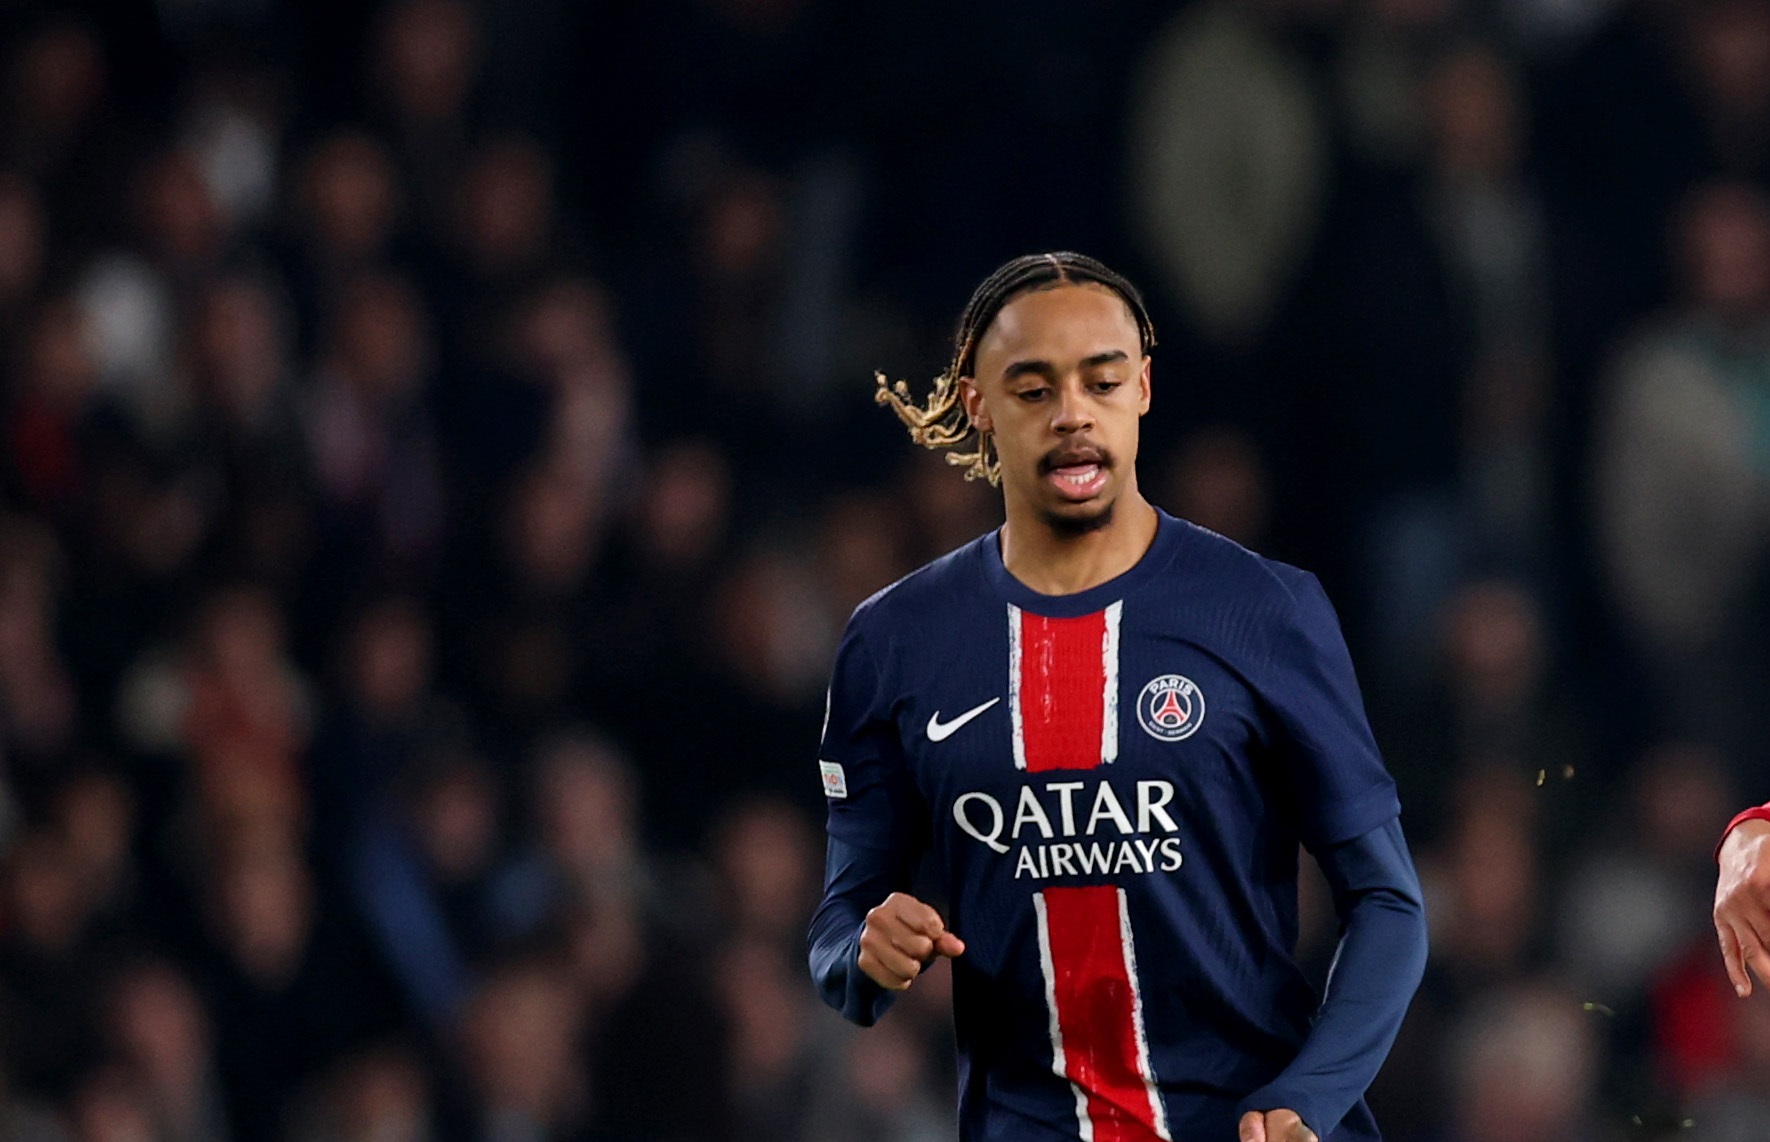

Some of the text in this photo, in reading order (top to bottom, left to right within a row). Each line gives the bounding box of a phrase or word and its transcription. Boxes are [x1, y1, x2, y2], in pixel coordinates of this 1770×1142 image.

[1148, 678, 1194, 696] PARIS
[952, 779, 1180, 854] QATAR
[1014, 837, 1183, 880] AIRWAYS
